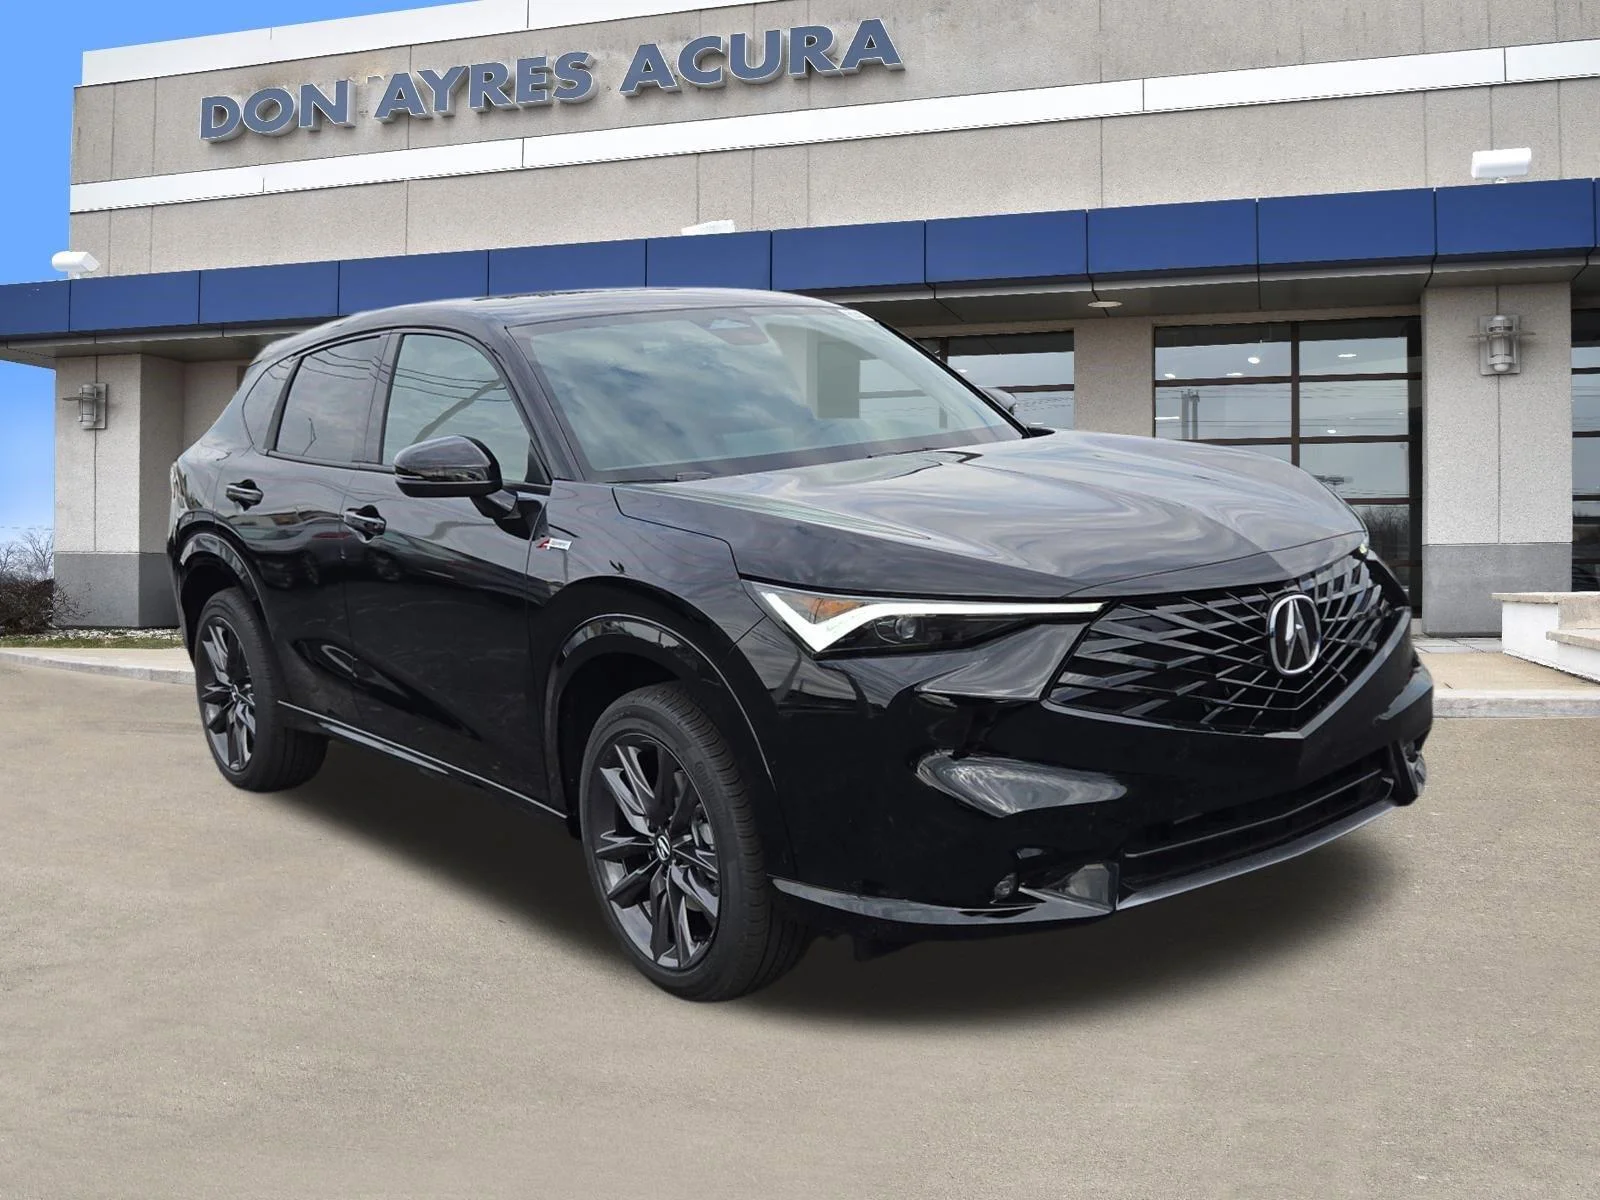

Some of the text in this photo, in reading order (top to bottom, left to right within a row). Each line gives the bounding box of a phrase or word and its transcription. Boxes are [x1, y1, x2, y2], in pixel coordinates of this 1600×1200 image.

[199, 18, 904, 141] DON AYRES ACURA
